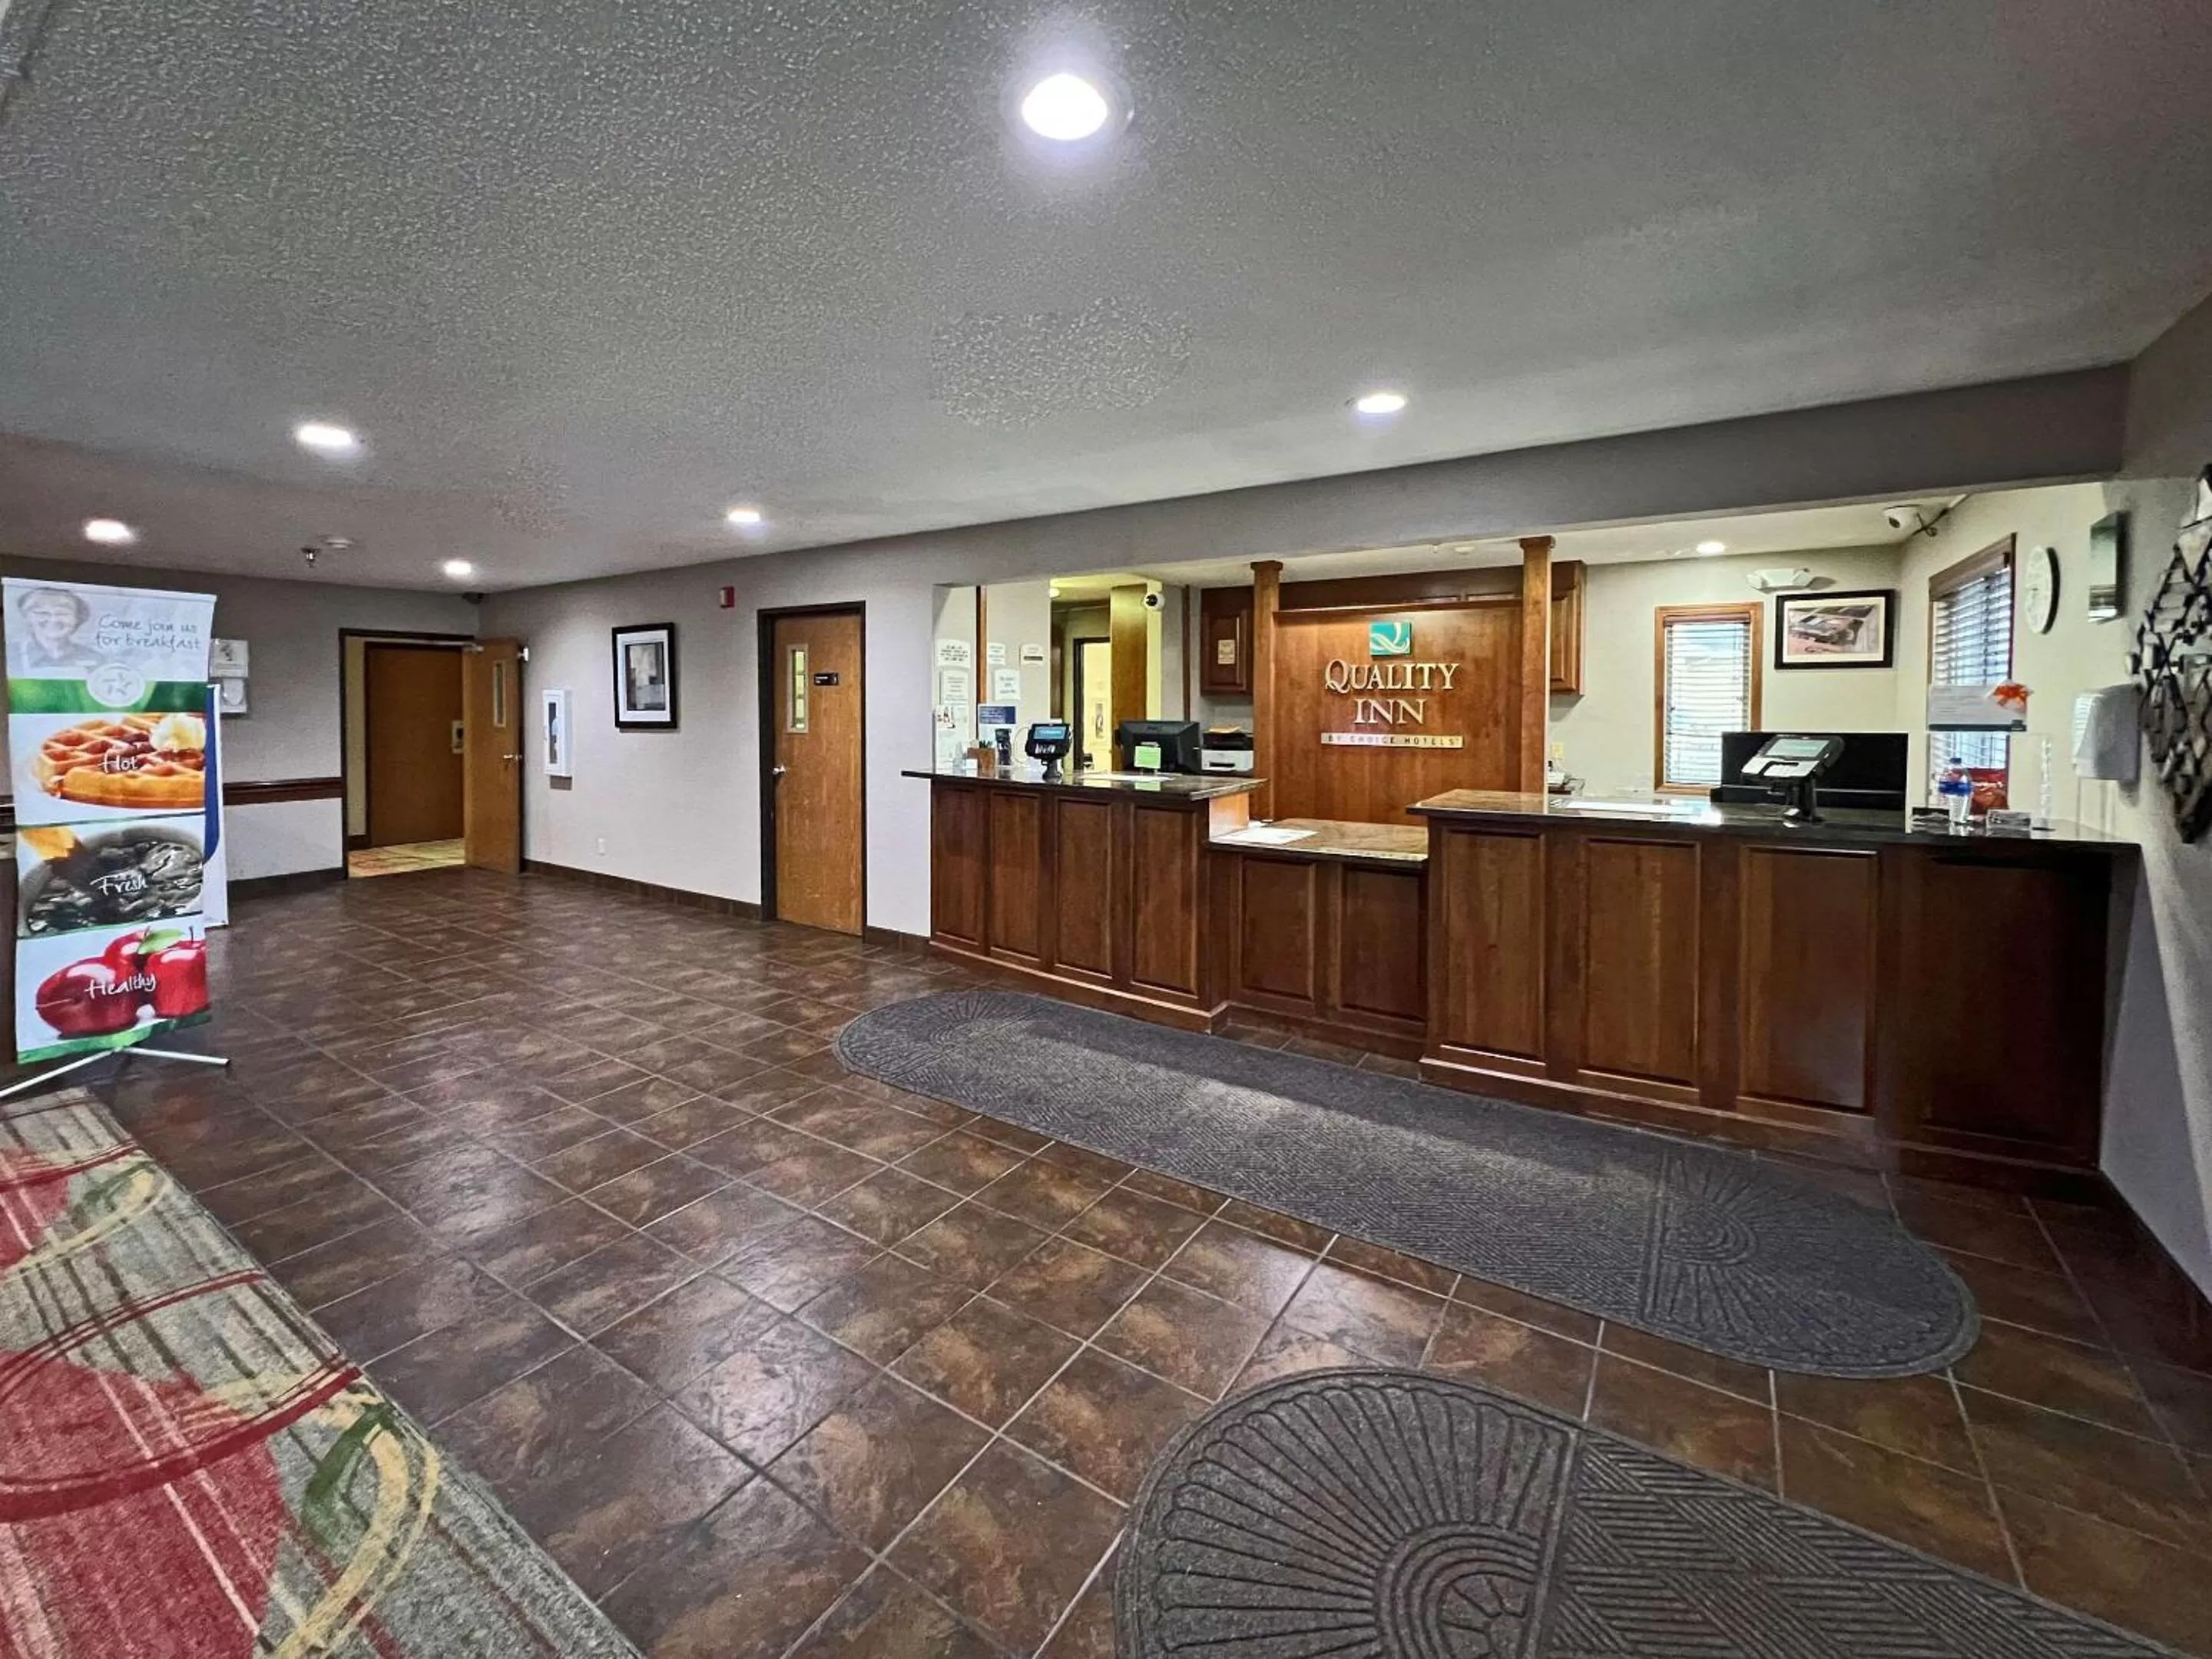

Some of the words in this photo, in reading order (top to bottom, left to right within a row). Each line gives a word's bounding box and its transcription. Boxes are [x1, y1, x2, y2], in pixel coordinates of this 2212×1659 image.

[99, 614, 142, 630] Come
[144, 618, 174, 635] join
[180, 623, 197, 633] us
[97, 630, 121, 649] for
[127, 633, 201, 653] breakfast
[1325, 659, 1459, 694] QUALITY
[1354, 698, 1427, 724] INN
[1349, 735, 1395, 744] CHOICE
[1405, 737, 1455, 747] HOTELS
[98, 750, 139, 774] Hot
[90, 874, 147, 896] Fresh
[85, 973, 157, 999] Healthy
